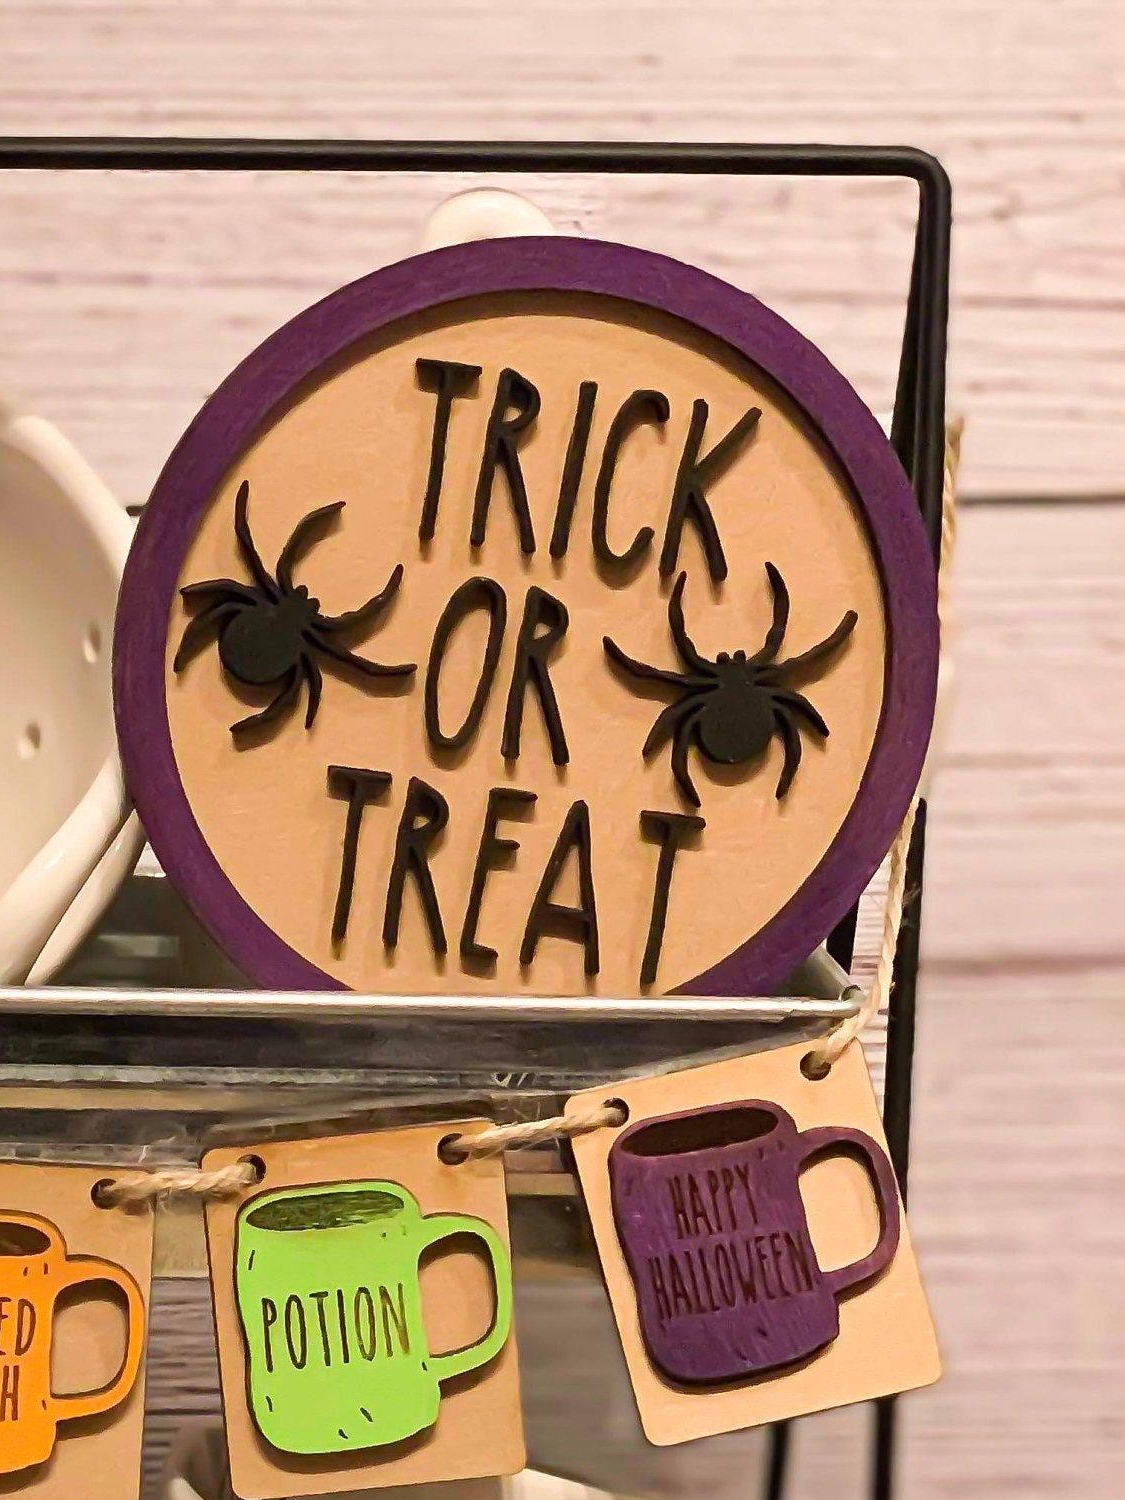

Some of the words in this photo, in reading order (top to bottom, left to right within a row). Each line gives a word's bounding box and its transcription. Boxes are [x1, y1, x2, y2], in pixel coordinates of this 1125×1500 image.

[415, 358, 763, 583] TRICK
[425, 576, 571, 766] OR
[326, 765, 706, 988] TREAT
[666, 1161, 761, 1241] HAPPY
[261, 1282, 412, 1373] POTION
[648, 1229, 820, 1322] HALLOWEEN
